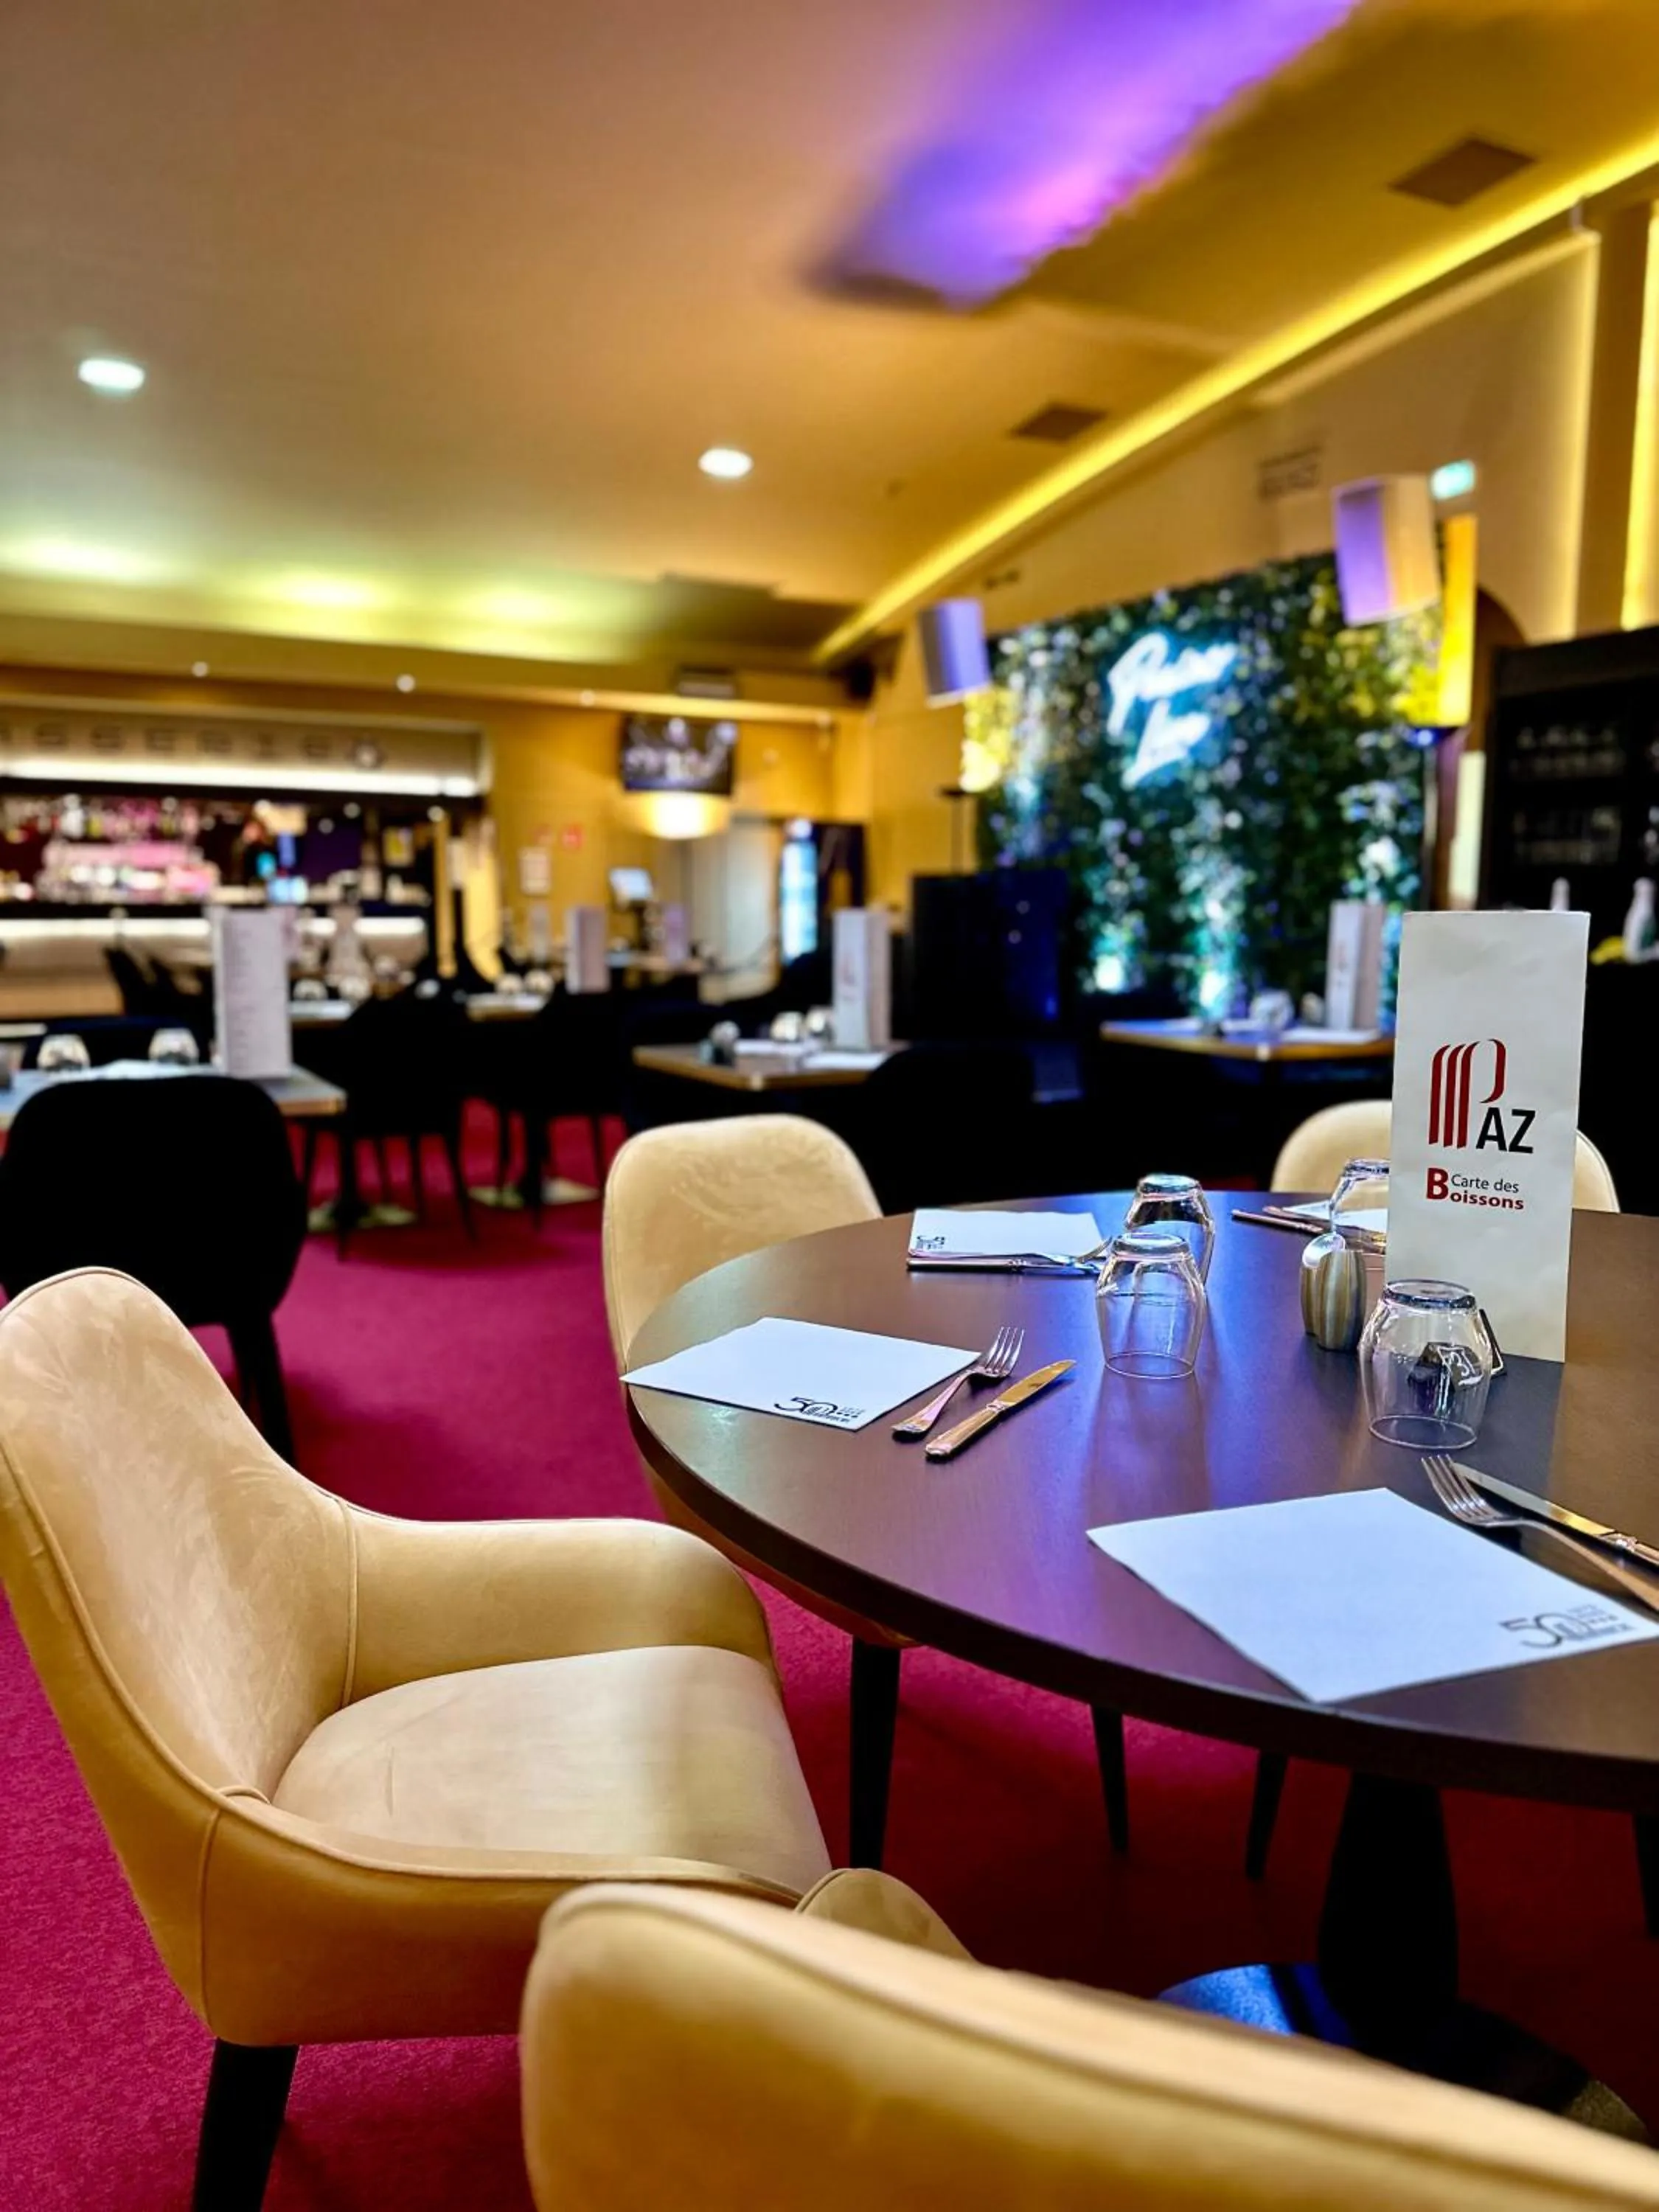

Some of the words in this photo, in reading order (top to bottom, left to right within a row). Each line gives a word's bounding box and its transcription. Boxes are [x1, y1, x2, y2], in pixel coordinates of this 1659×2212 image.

[1426, 1167, 1524, 1210] Boissons
[1451, 1174, 1489, 1189] Carte
[1493, 1178, 1520, 1193] des
